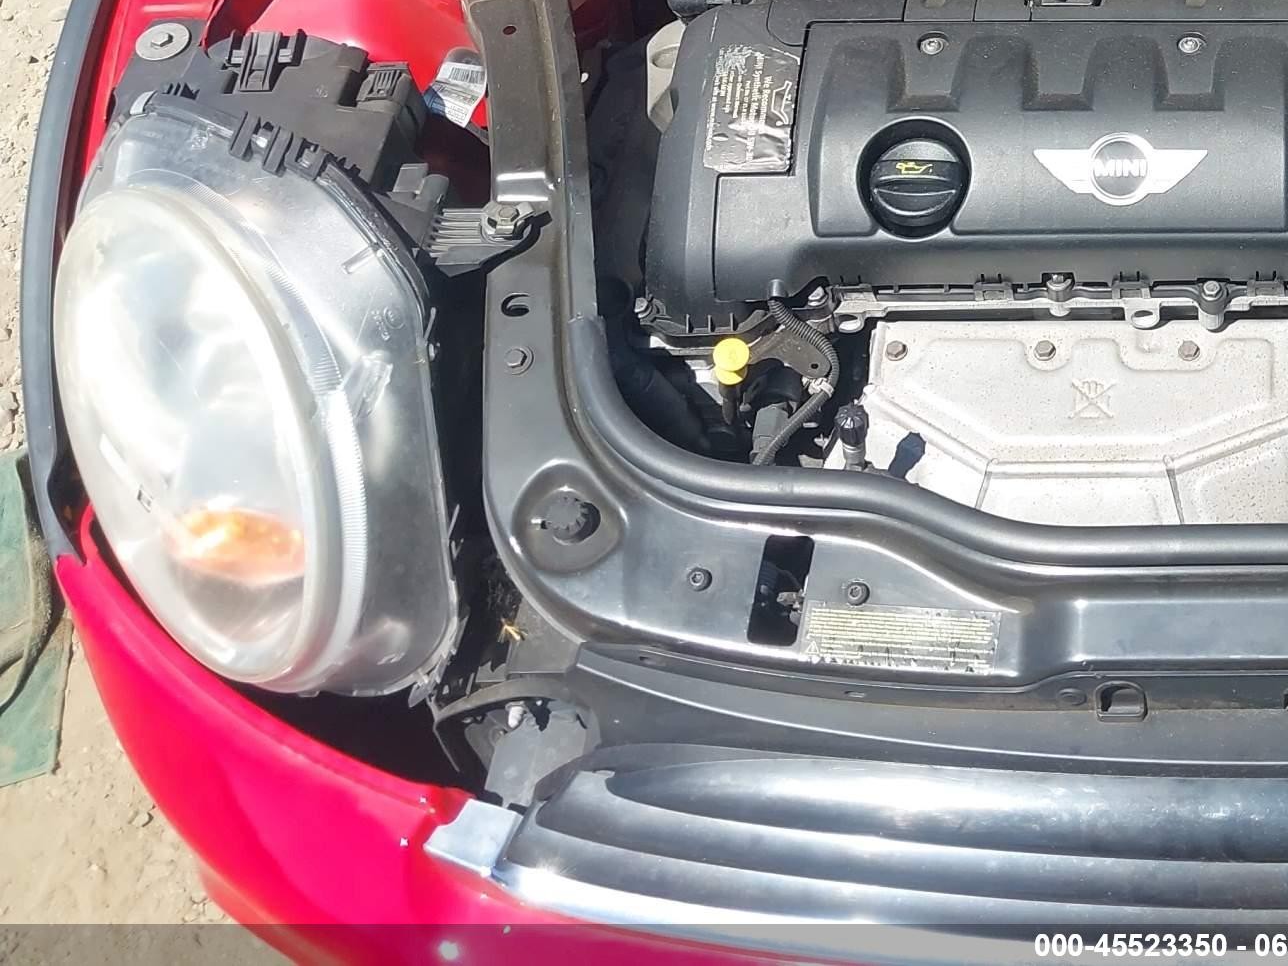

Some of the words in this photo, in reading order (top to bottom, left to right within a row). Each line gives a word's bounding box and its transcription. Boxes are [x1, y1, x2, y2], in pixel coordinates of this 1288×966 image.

[751, 70, 762, 102] Synthetic
[764, 75, 774, 88] We
[759, 88, 769, 133] Recomme
[1094, 158, 1147, 179] MINI
